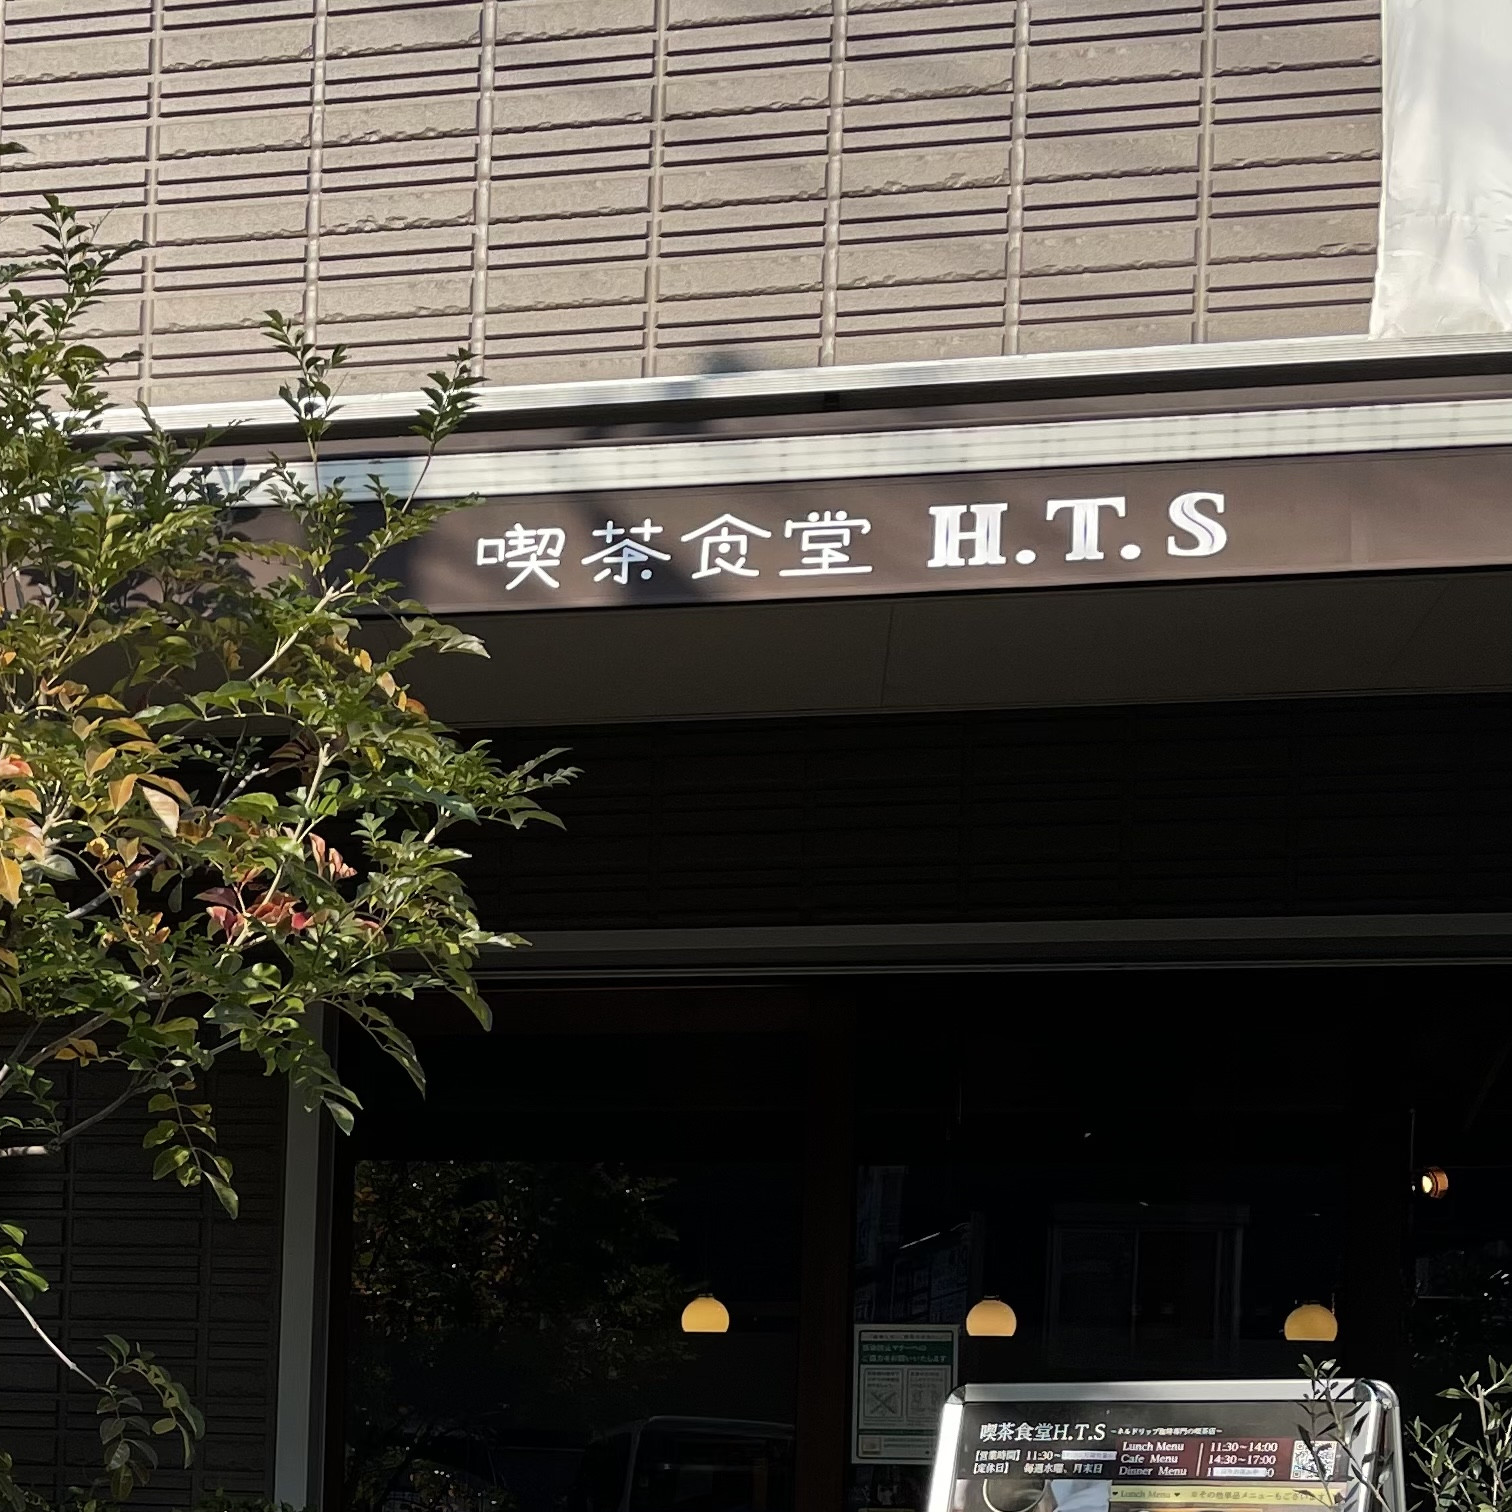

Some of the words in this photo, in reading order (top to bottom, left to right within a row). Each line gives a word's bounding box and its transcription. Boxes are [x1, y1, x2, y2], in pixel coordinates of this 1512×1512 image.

[475, 510, 874, 591] 喫茶食堂
[926, 490, 1229, 569] H.T.S
[1122, 1441, 1154, 1451] Lunch
[1155, 1442, 1185, 1451] Menu
[1121, 1454, 1145, 1464] Cafe
[1150, 1454, 1179, 1464] Menu
[1119, 1467, 1153, 1476] Dinner
[1158, 1467, 1188, 1476] Menu
